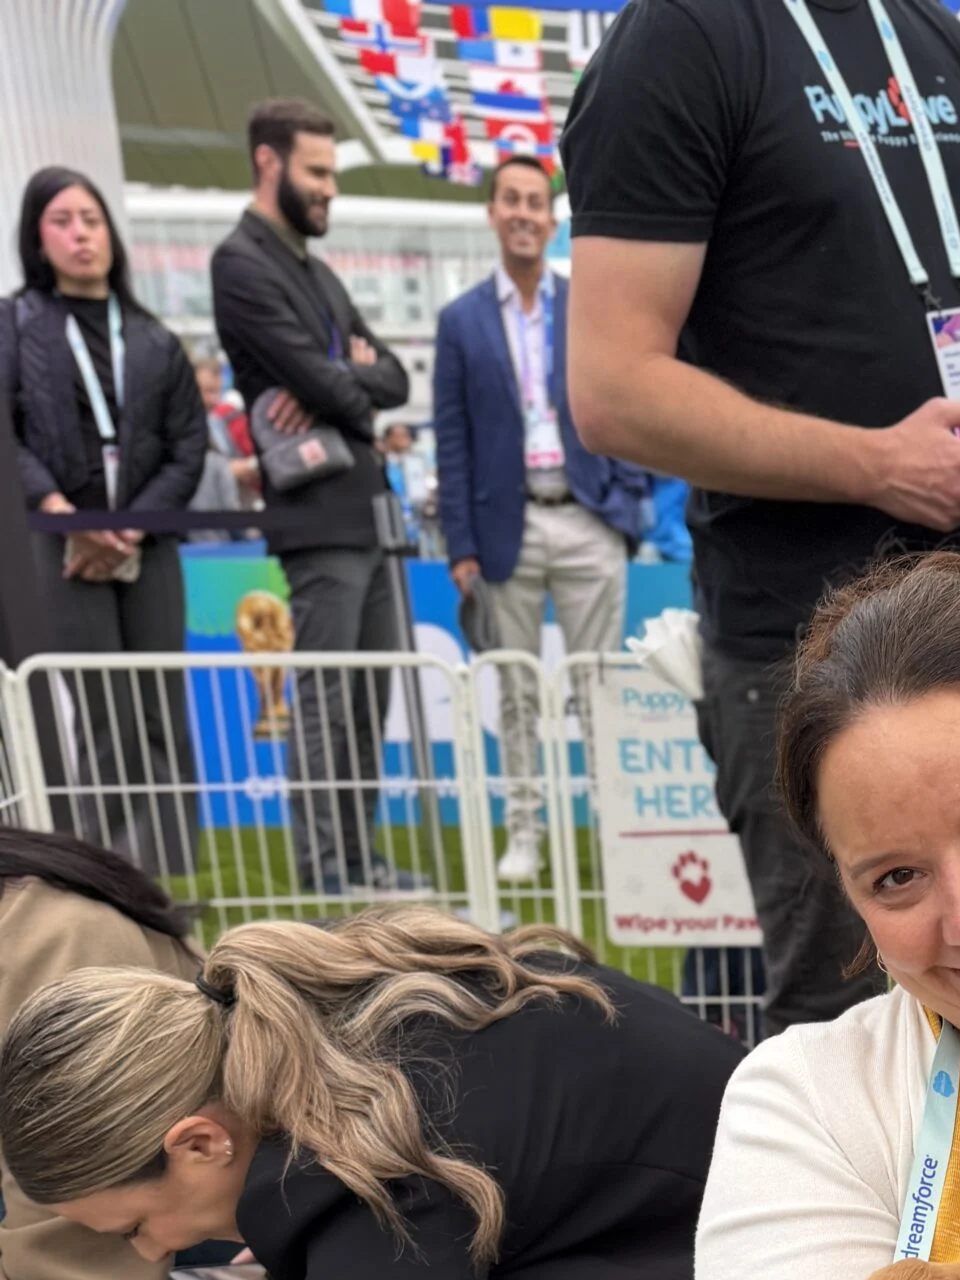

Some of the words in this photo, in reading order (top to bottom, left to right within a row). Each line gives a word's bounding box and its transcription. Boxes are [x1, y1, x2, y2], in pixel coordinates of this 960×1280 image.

[622, 687, 688, 711] Puppy
[616, 736, 718, 775] ENT
[633, 783, 715, 820] HER
[614, 913, 668, 934] Wipe
[673, 916, 718, 936] your
[722, 914, 760, 932] Paw
[900, 1155, 939, 1260] dreamforce
